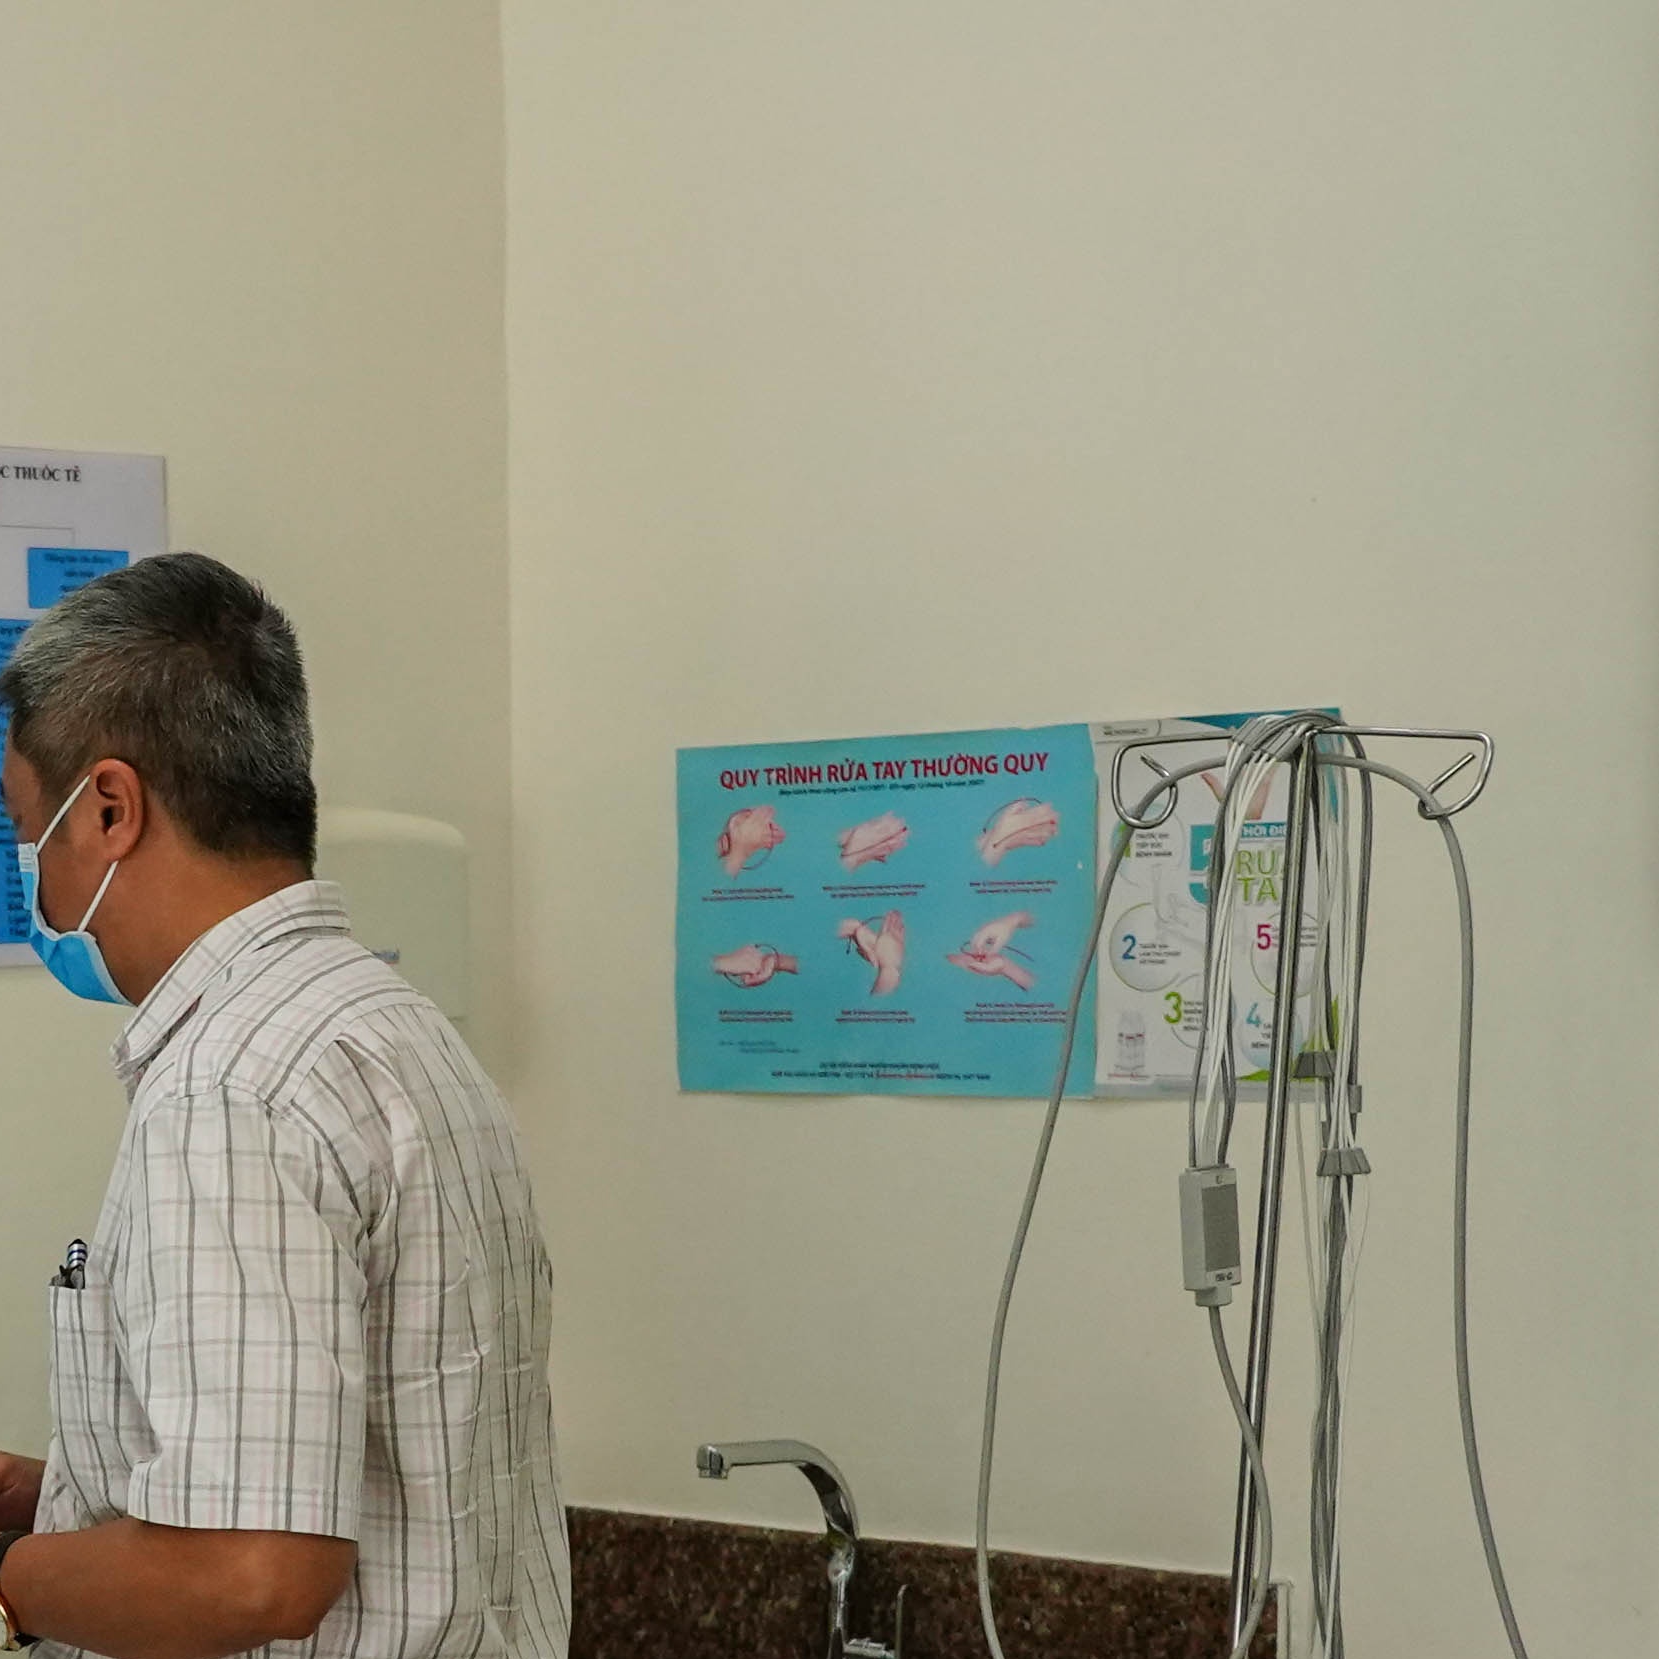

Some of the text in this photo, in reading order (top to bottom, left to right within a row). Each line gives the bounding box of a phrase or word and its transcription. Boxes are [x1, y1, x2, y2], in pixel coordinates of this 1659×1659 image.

[719, 767, 760, 790] QUY
[764, 762, 822, 786] TRÌNH
[827, 757, 868, 783] RỬA
[871, 760, 906, 780] TAY
[910, 752, 999, 778] THƯỜNG
[1003, 752, 1049, 776] QUY
[1122, 934, 1136, 960] 2
[1257, 924, 1272, 950] 5
[1164, 991, 1181, 1024] 3
[1246, 1002, 1261, 1027] 4
